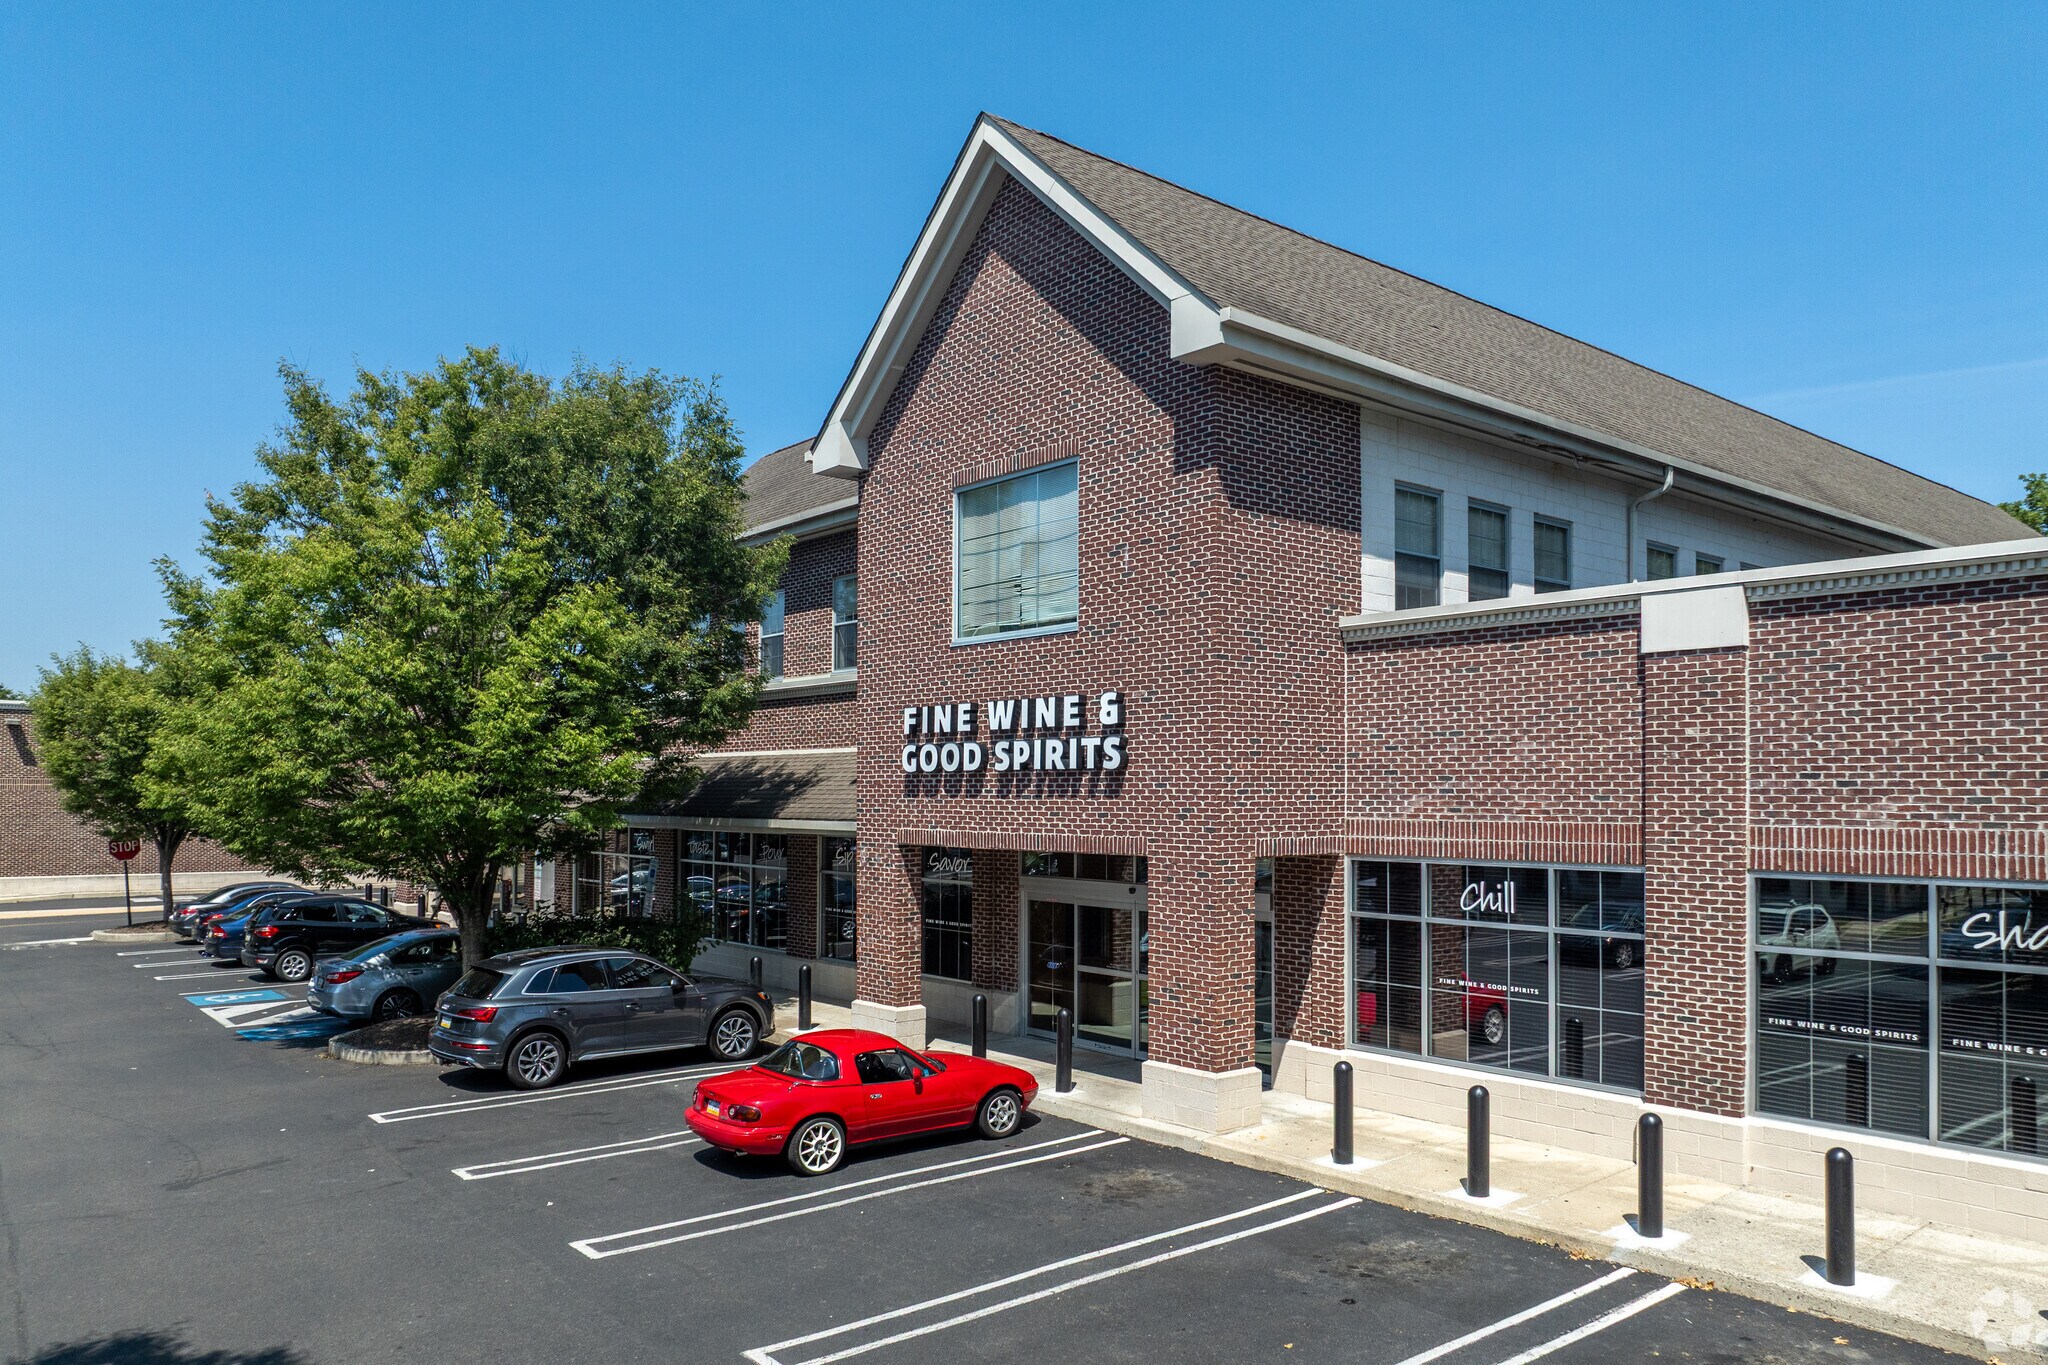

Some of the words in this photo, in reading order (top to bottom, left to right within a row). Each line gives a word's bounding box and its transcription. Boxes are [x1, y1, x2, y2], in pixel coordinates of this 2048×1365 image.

[903, 703, 972, 735] FINE
[987, 694, 1081, 730] WINE
[1099, 691, 1120, 725] &
[902, 742, 983, 773] GOOD
[994, 736, 1123, 771] SPIRITS
[110, 840, 139, 853] STOP
[687, 840, 711, 855] Taste
[761, 844, 785, 860] Pour
[835, 846, 854, 872] Sip
[929, 852, 973, 872] Savor
[1460, 881, 1516, 914] Chill
[1458, 980, 1477, 988] WINE
[1487, 983, 1508, 991] GOOD
[1510, 986, 1540, 995] SPIRITS
[1768, 1017, 1793, 1027] FINE
[1797, 1020, 1825, 1030] WINE
[1840, 1025, 1870, 1035] GOOD
[1874, 1029, 1919, 1041] SPIRITS
[1952, 1038, 1981, 1049] FINE
[1987, 1042, 2021, 1053] WINE
[2026, 1047, 2034, 1055] &
